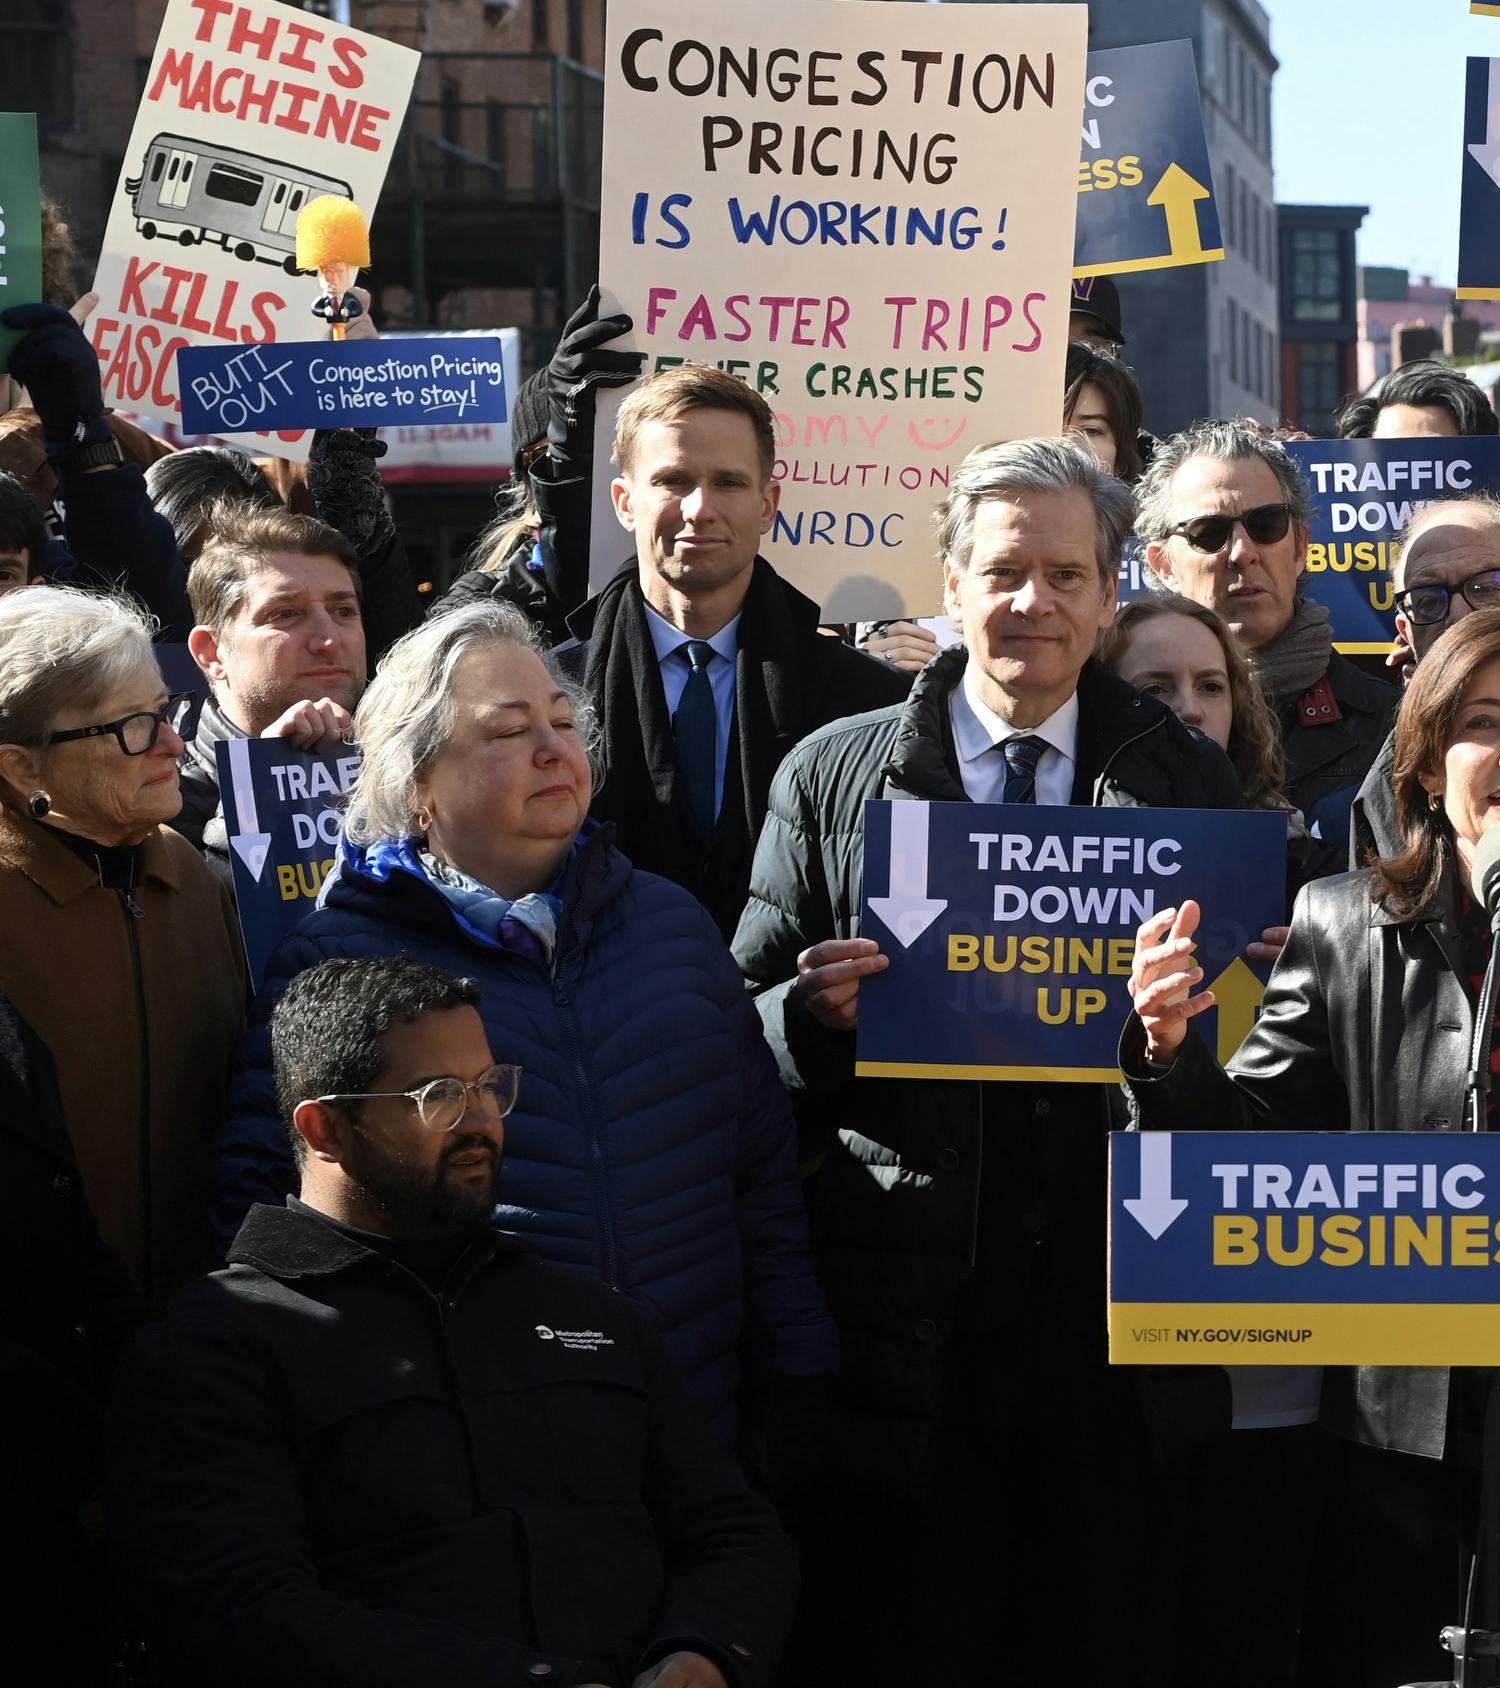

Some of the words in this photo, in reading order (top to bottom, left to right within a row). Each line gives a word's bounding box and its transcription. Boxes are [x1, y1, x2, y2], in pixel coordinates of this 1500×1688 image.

[191, 0, 367, 88] THIS
[620, 27, 1054, 113] CONGESTION
[148, 48, 390, 152] MACHINE
[702, 115, 958, 184] PRICING
[632, 192, 693, 250] IS
[727, 194, 1007, 252] WORKING!
[119, 256, 286, 344] KILLS
[646, 288, 850, 349] FASTER
[884, 291, 1046, 352] TRIPS
[191, 345, 268, 411] BUTT
[219, 360, 293, 427] OUT
[309, 357, 428, 392] Congestion
[430, 354, 502, 385] Pricing
[806, 361, 985, 403] CRASHES
[317, 390, 335, 411] is
[340, 387, 388, 410] here
[391, 385, 415, 407] to
[420, 381, 477, 417] stay!
[770, 459, 949, 490] OLLUTION
[1310, 459, 1473, 493] TRAFFIC
[772, 511, 904, 546] NRDC
[1331, 500, 1420, 533] DOW
[1306, 541, 1398, 572] BUSI
[1369, 581, 1394, 611] U
[271, 756, 362, 801] TRAF
[969, 832, 1183, 876] TRAFFIC
[993, 884, 1155, 925] DOWN
[947, 934, 1133, 976] BUSINE
[1036, 987, 1107, 1025] UP
[1211, 1164, 1486, 1209] TRAFFIC
[1132, 1329, 1171, 1343] VISIT
[1176, 1328, 1313, 1344] NY.GOV/SIGNUP
